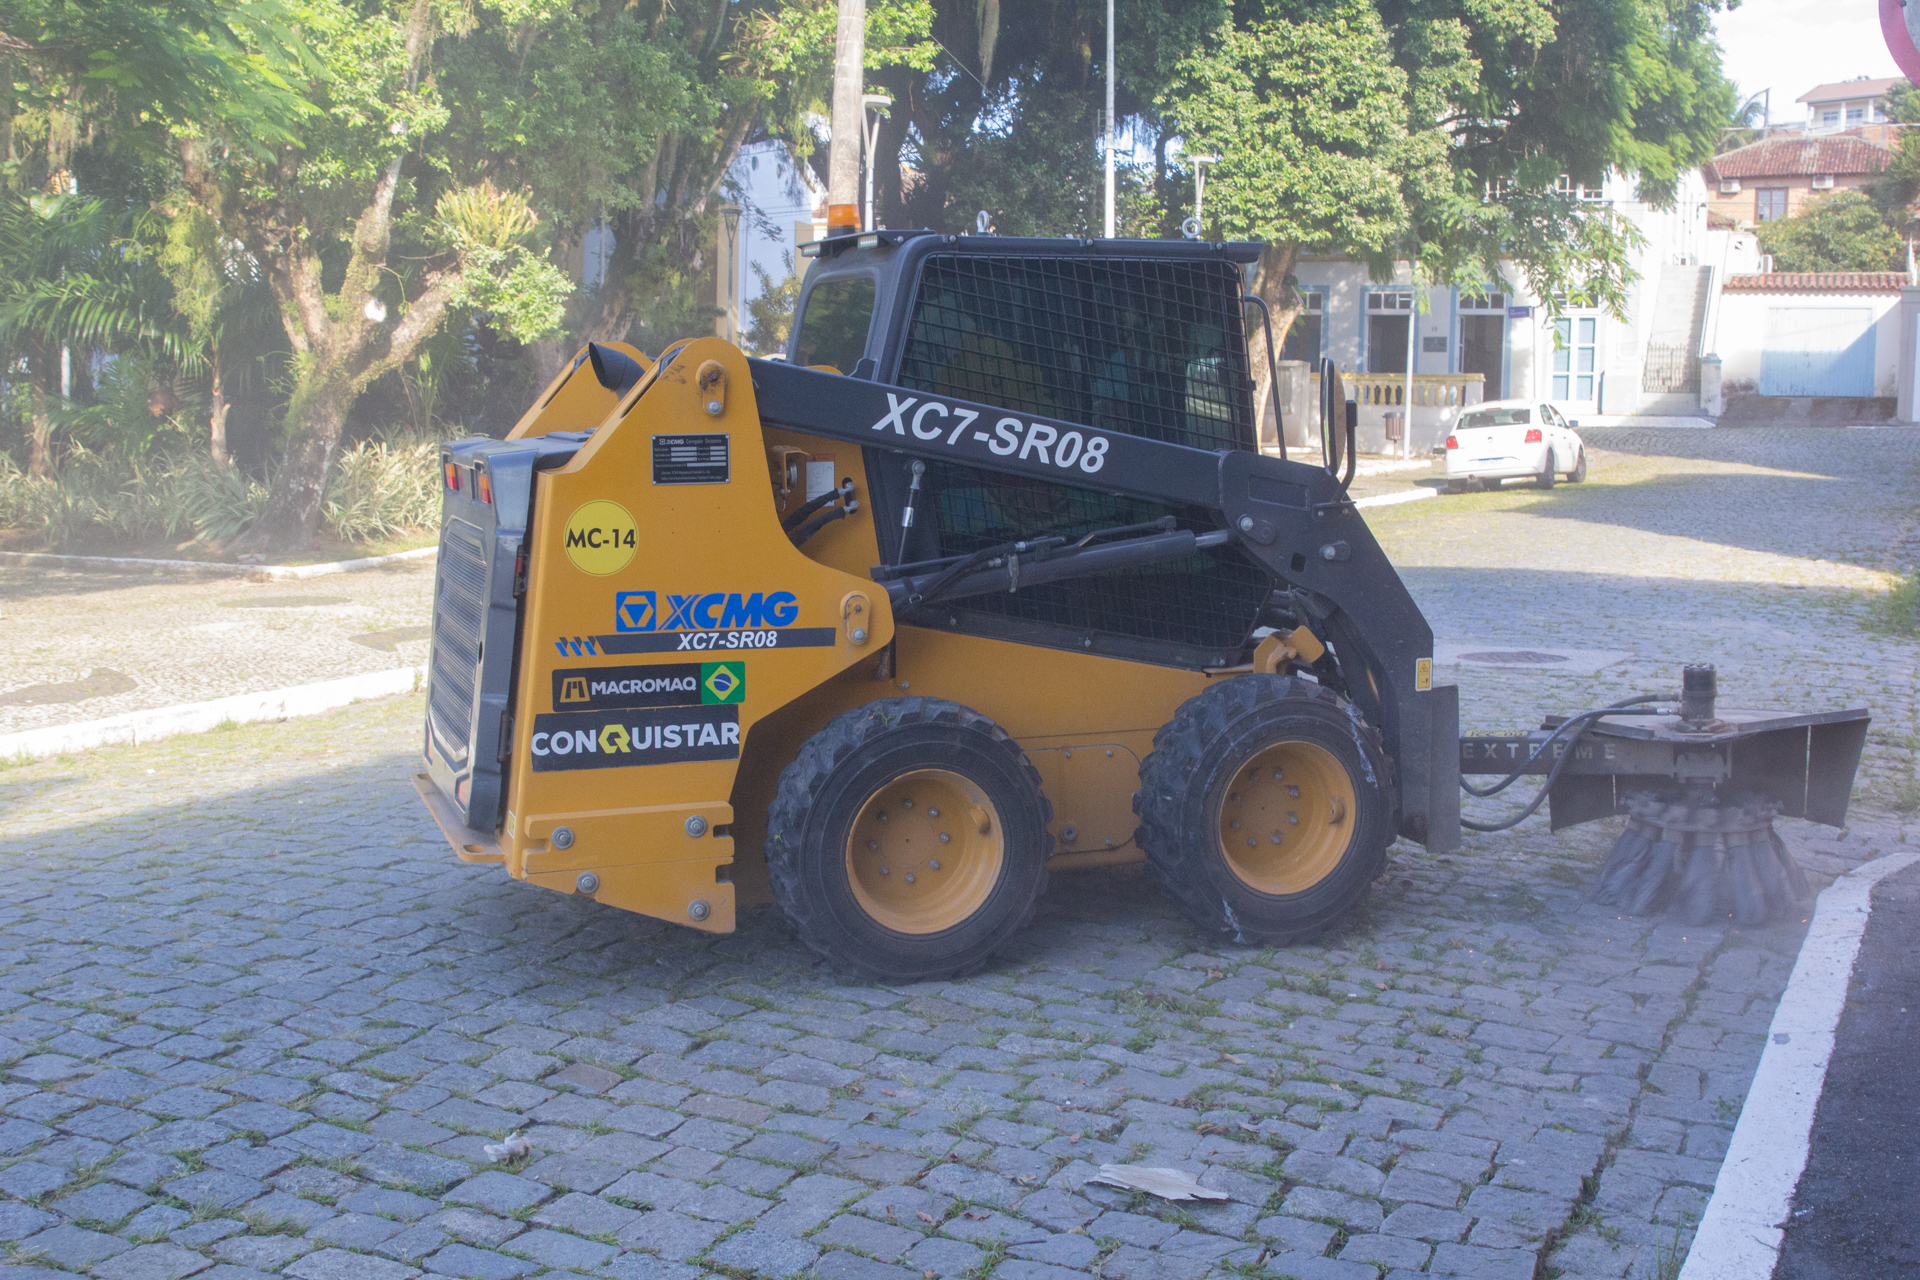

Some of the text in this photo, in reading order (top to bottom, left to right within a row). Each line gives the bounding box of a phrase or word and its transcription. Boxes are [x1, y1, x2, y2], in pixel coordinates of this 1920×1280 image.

[873, 393, 1109, 473] XC7-SR08
[566, 528, 636, 549] MC-14
[659, 590, 799, 630] XCMG
[677, 630, 778, 651] XC7-SR08
[591, 677, 697, 696] MACROMAQ
[531, 723, 740, 756] CONQUISTAR
[1462, 742, 1616, 760] EXTREME
